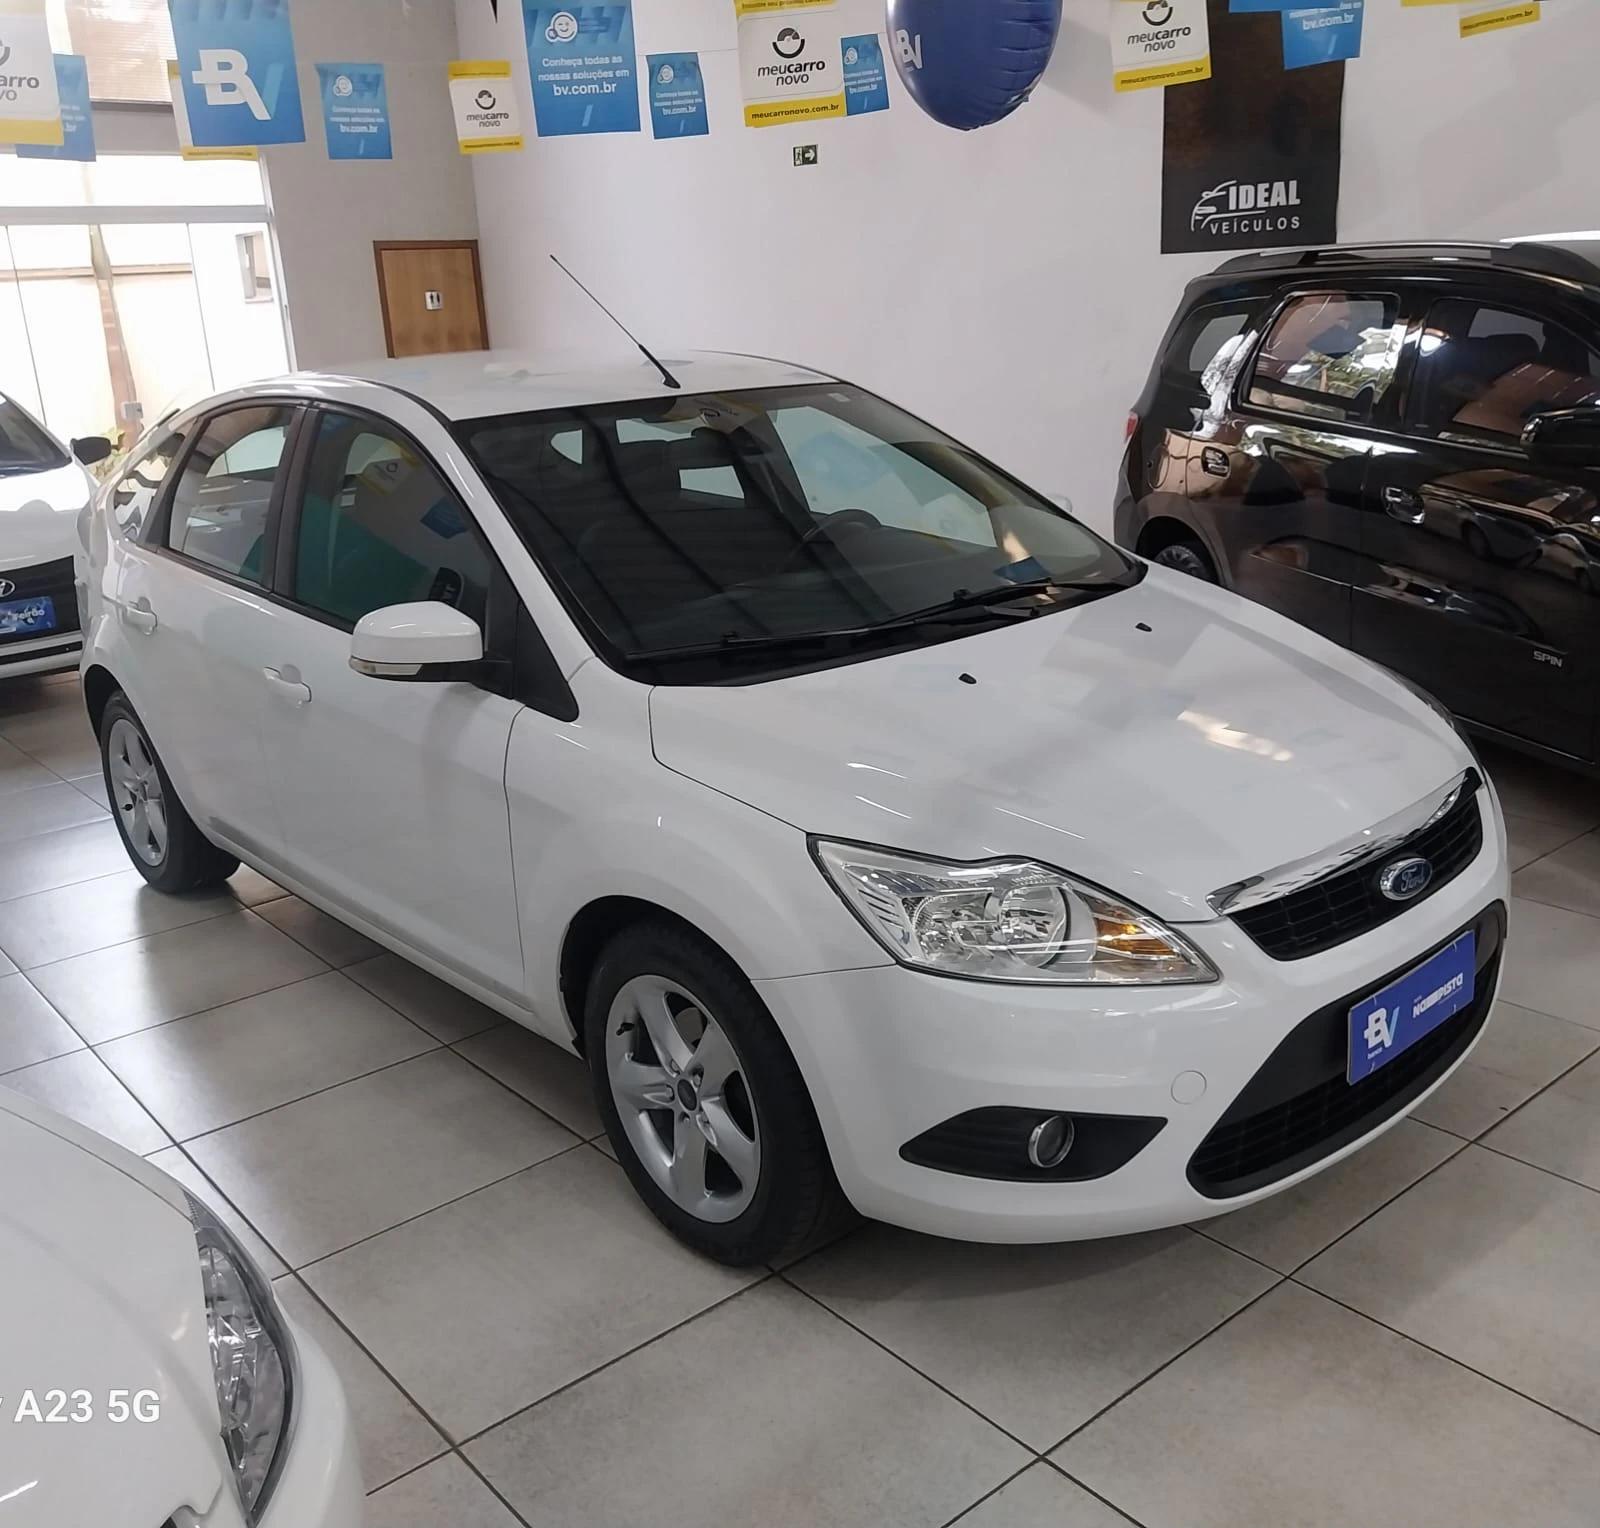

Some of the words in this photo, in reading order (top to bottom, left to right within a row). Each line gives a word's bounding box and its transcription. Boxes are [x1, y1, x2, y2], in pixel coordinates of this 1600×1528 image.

[1127, 26, 1191, 45] meucarro
[1144, 39, 1176, 53] novo
[585, 56, 609, 65] todas
[611, 56, 623, 64] as
[757, 60, 826, 77] meucarro
[192, 48, 284, 120] BV
[776, 73, 809, 86] novo
[553, 81, 616, 96] bv.com.br
[466, 112, 509, 121] meucarro
[751, 104, 840, 119] meucarronovo.com.br
[479, 120, 501, 128] novo
[1228, 180, 1300, 210] IDEAL
[1210, 216, 1300, 235] VEÍCULOS
[1533, 650, 1562, 667] SPIN
[1401, 863, 1425, 892] Ford
[1363, 1007, 1400, 1048] BV
